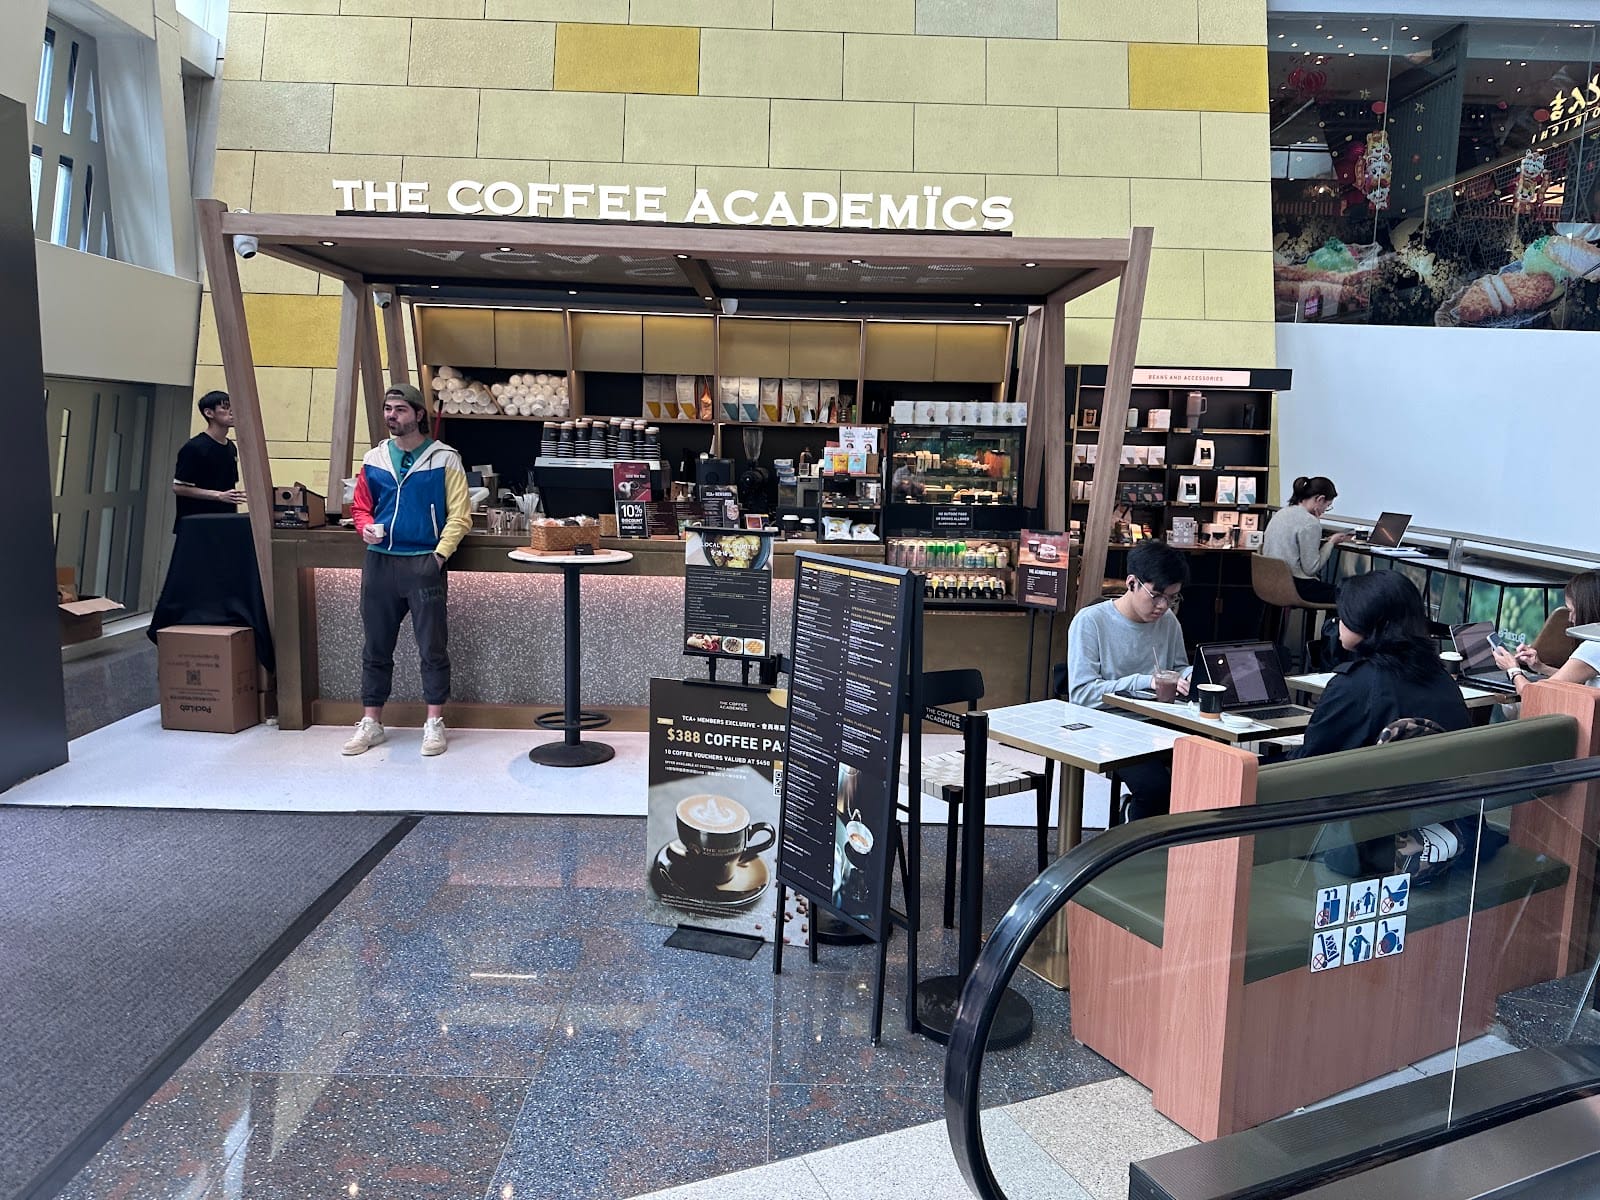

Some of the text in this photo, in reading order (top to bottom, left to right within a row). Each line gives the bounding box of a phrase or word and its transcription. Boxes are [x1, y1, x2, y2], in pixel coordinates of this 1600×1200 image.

[332, 180, 430, 213] THE
[447, 180, 667, 222] COFFEE
[621, 504, 643, 517] 10%
[936, 710, 960, 722] COFFEE
[697, 717, 724, 725] MEMBERS
[725, 720, 756, 729] EXCLUSIVE
[667, 728, 701, 744] $388
[704, 732, 758, 750] COFFEE
[672, 750, 692, 758] COFFEE
[694, 752, 723, 761] VOUCHERS
[724, 756, 747, 764] VALUED
